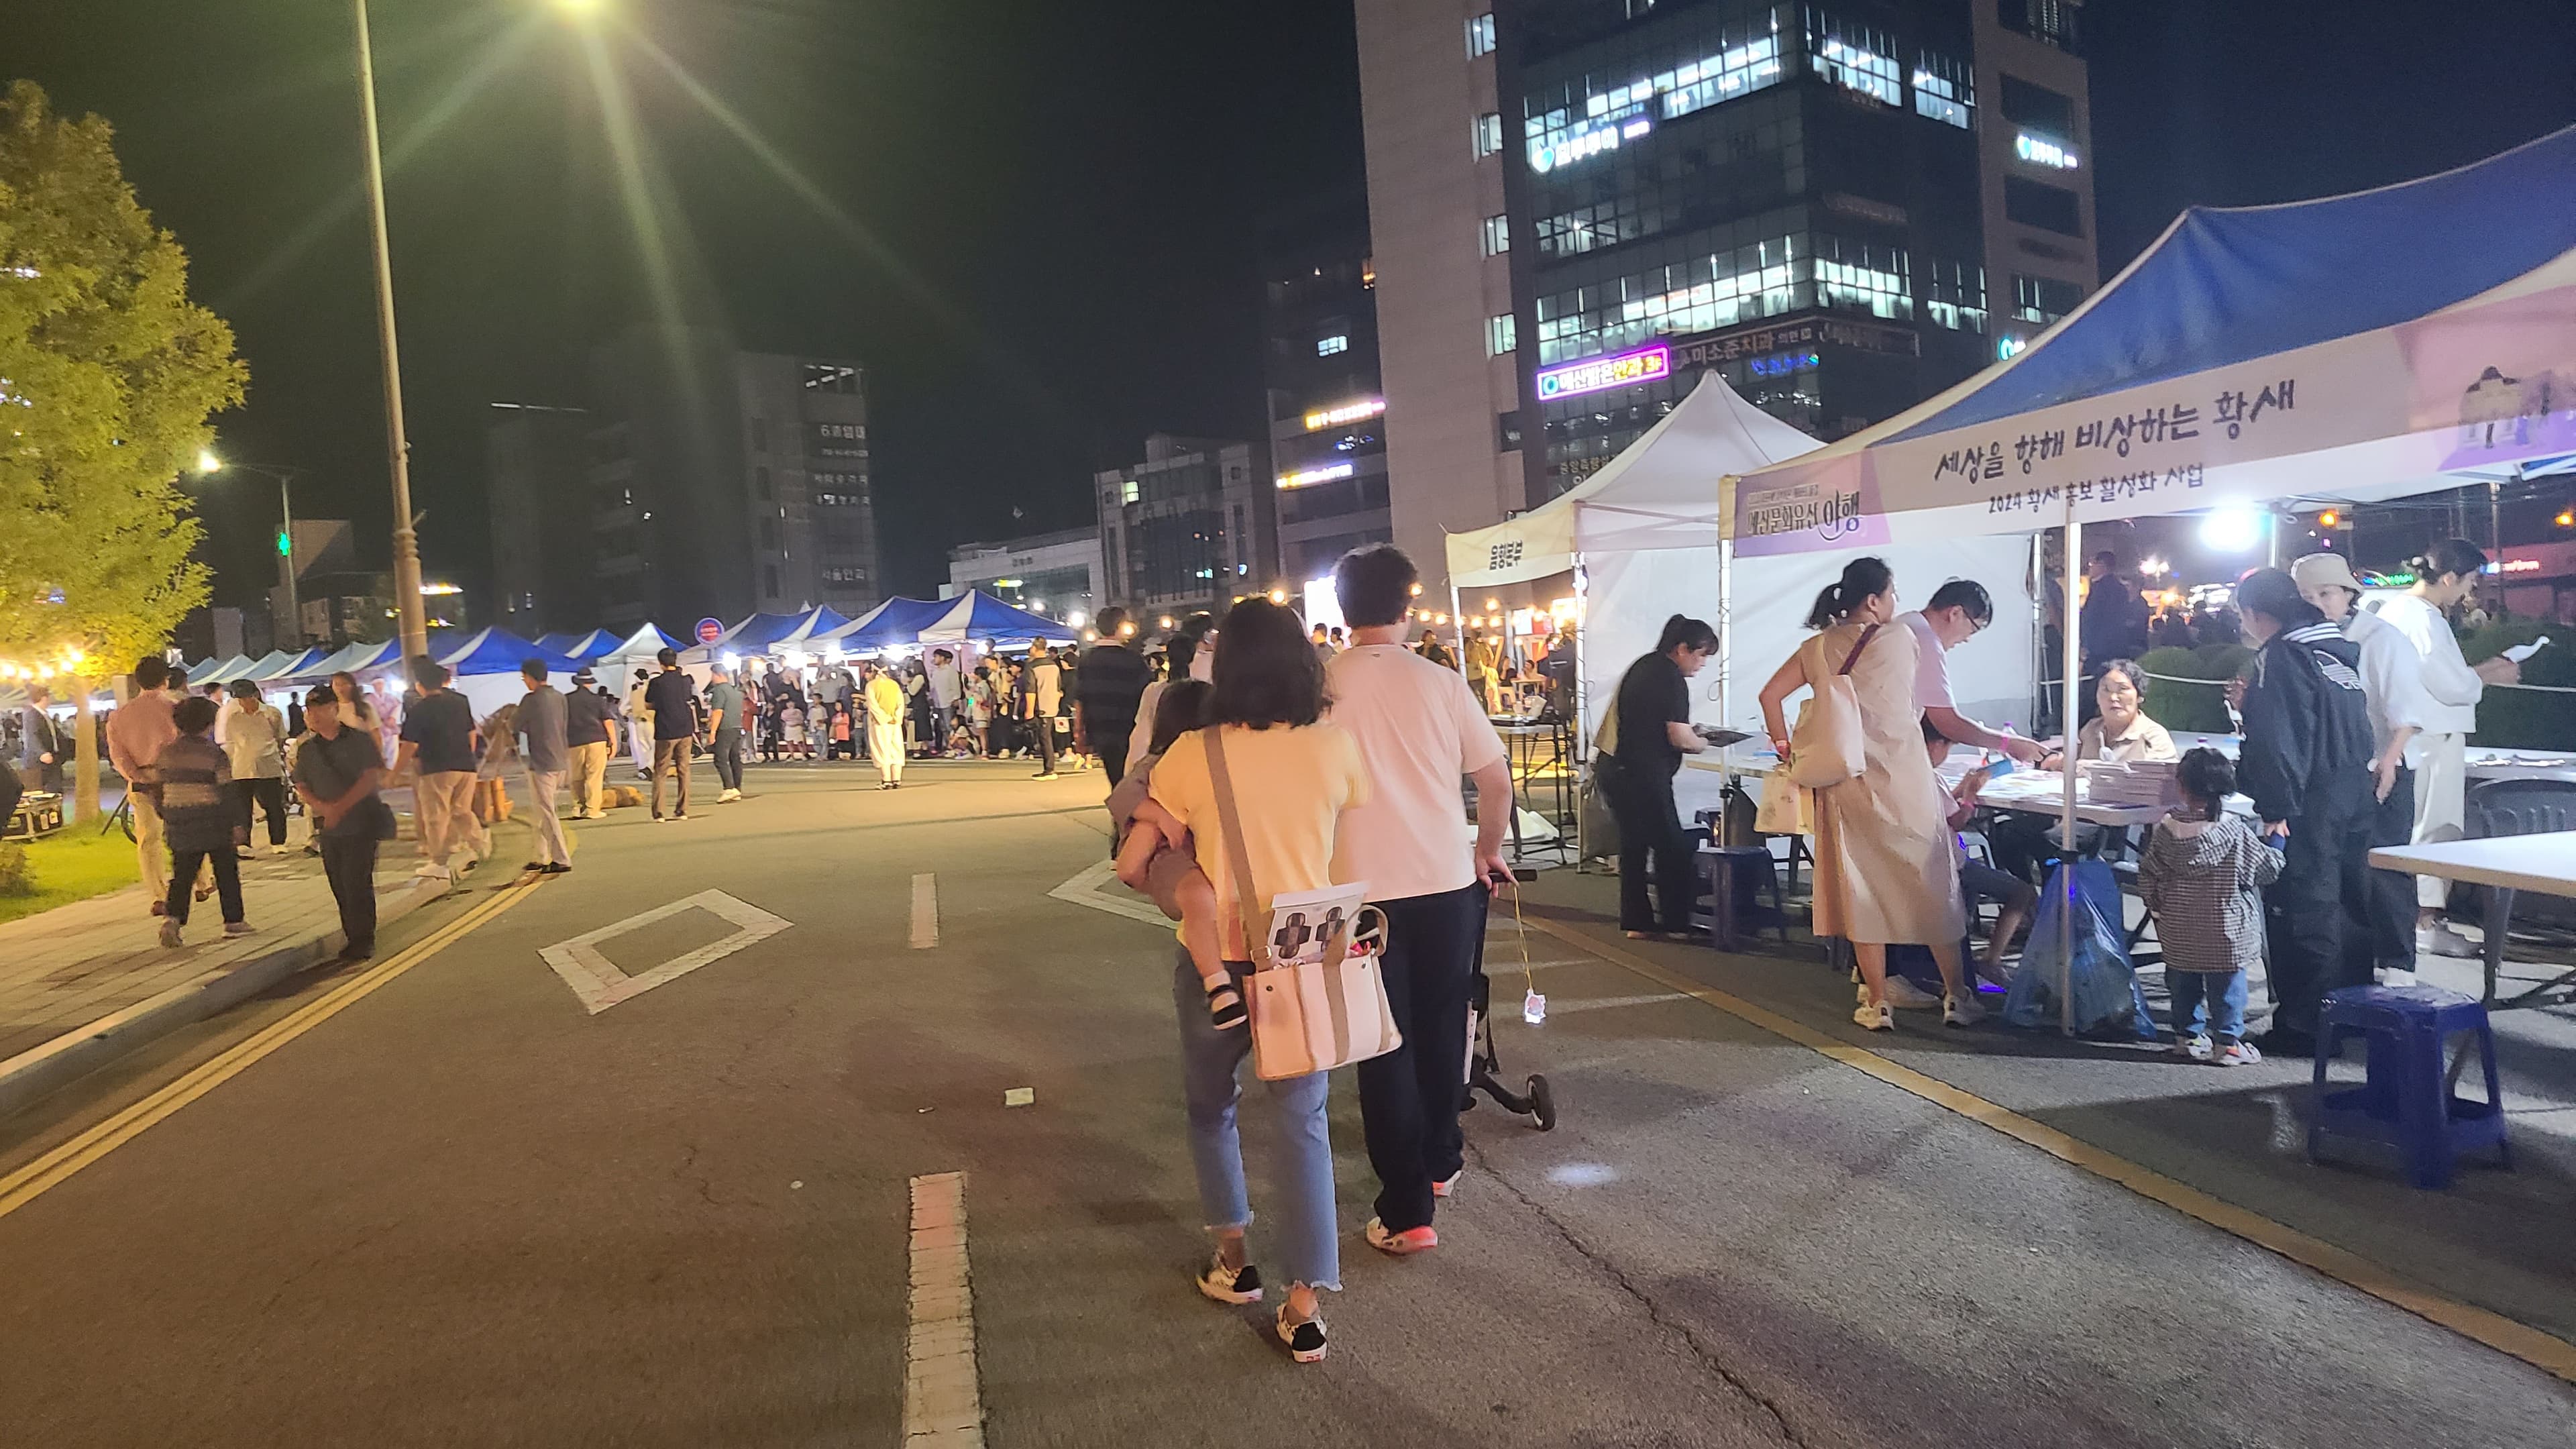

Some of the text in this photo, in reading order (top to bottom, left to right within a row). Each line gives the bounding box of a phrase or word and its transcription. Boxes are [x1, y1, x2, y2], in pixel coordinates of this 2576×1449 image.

[1935, 380, 2294, 484] 세상을 향해 비상하는 황새
[1823, 488, 1860, 533] 야행
[1988, 463, 2202, 514] 2024 황새 홍보 활성화 사업
